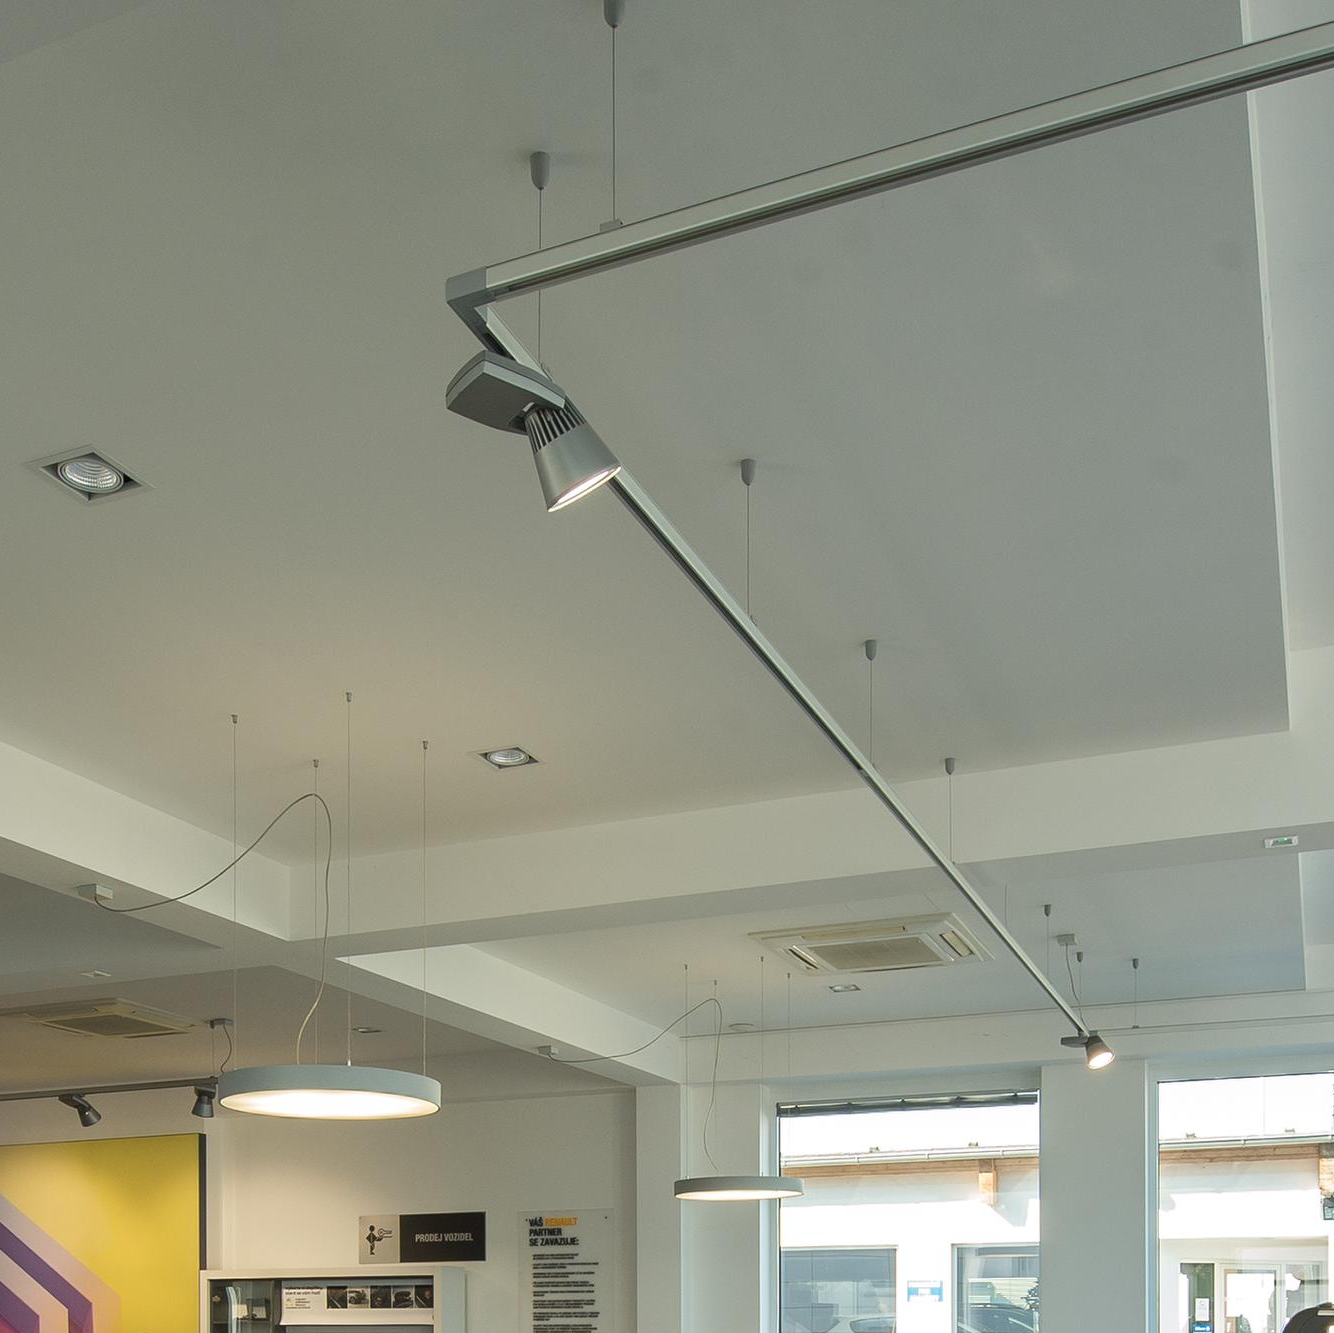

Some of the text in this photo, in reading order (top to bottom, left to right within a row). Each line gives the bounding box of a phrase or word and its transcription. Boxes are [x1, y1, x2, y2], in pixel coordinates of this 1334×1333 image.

[415, 1232, 474, 1242] PRODEJ VOZIDEL
[529, 1228, 562, 1237] PARTNER
